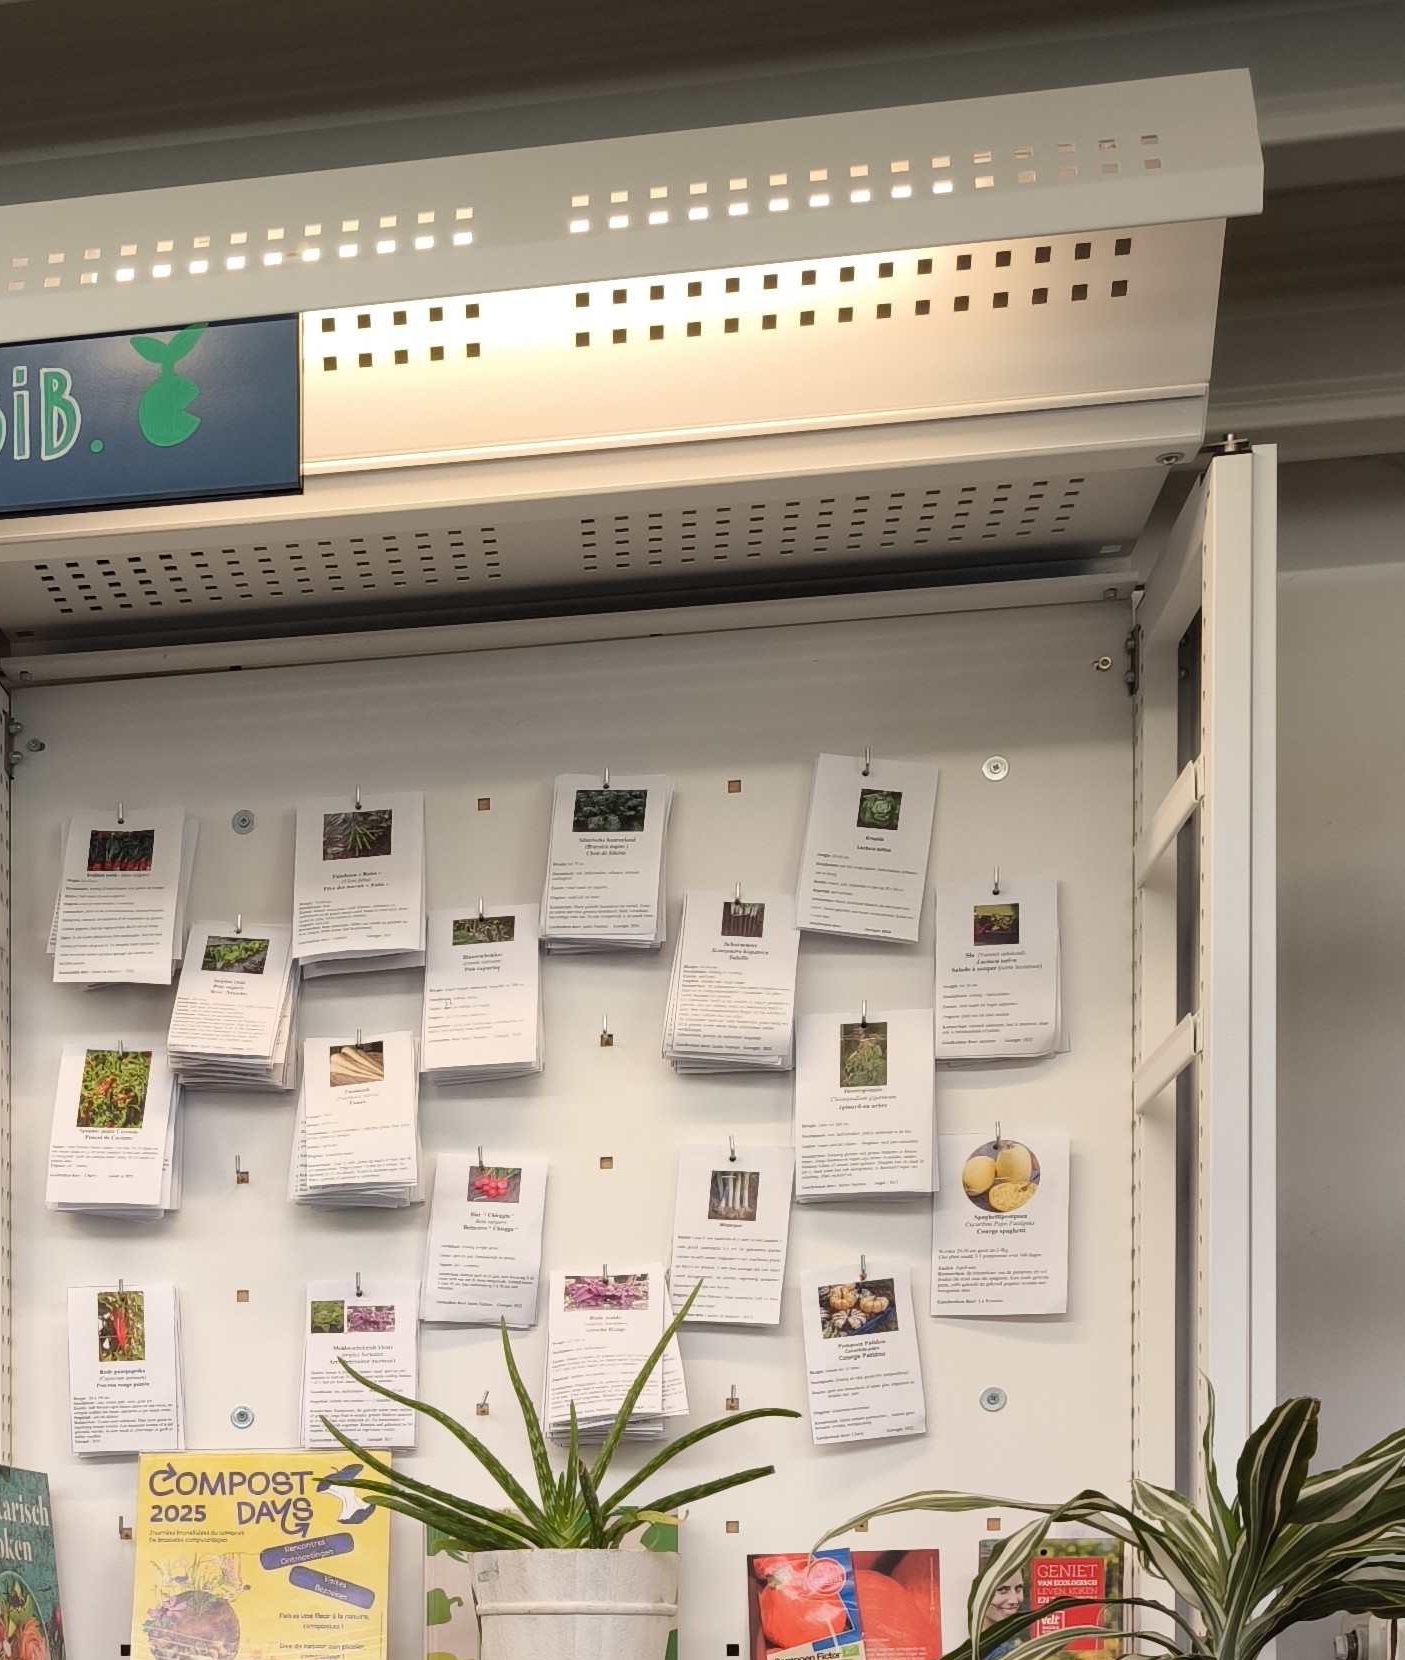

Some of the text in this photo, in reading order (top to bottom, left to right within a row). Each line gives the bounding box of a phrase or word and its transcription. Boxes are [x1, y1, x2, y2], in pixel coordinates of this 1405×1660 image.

[148, 1463, 314, 1497] COMPOST
[149, 1504, 207, 1523] 2025
[237, 1497, 315, 1537] DAYS
[1038, 1565, 1097, 1578] GENIET
[817, 1652, 840, 1660] Fictor
